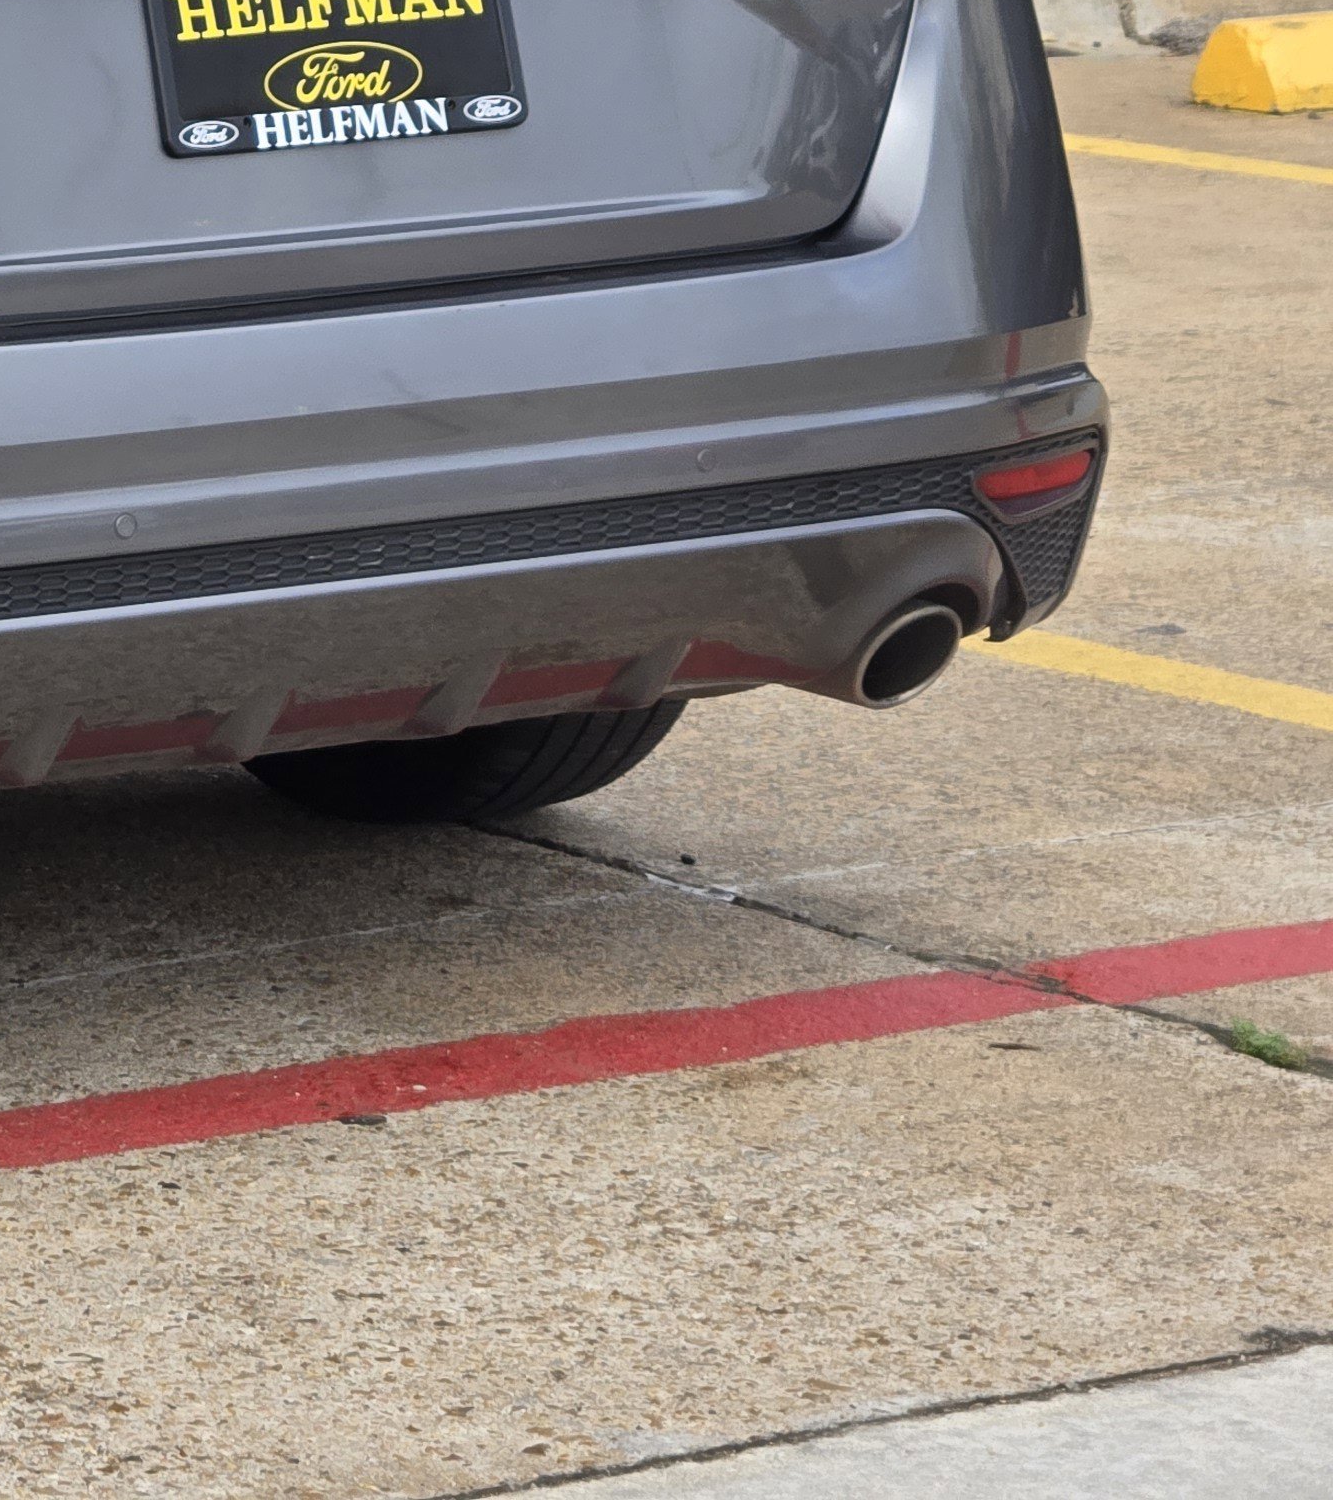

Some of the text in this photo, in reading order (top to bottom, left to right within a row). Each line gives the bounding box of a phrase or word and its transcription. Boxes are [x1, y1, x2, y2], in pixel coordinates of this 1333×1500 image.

[295, 50, 392, 105] Ford
[188, 96, 513, 150] Ford HELFMAN Ford
